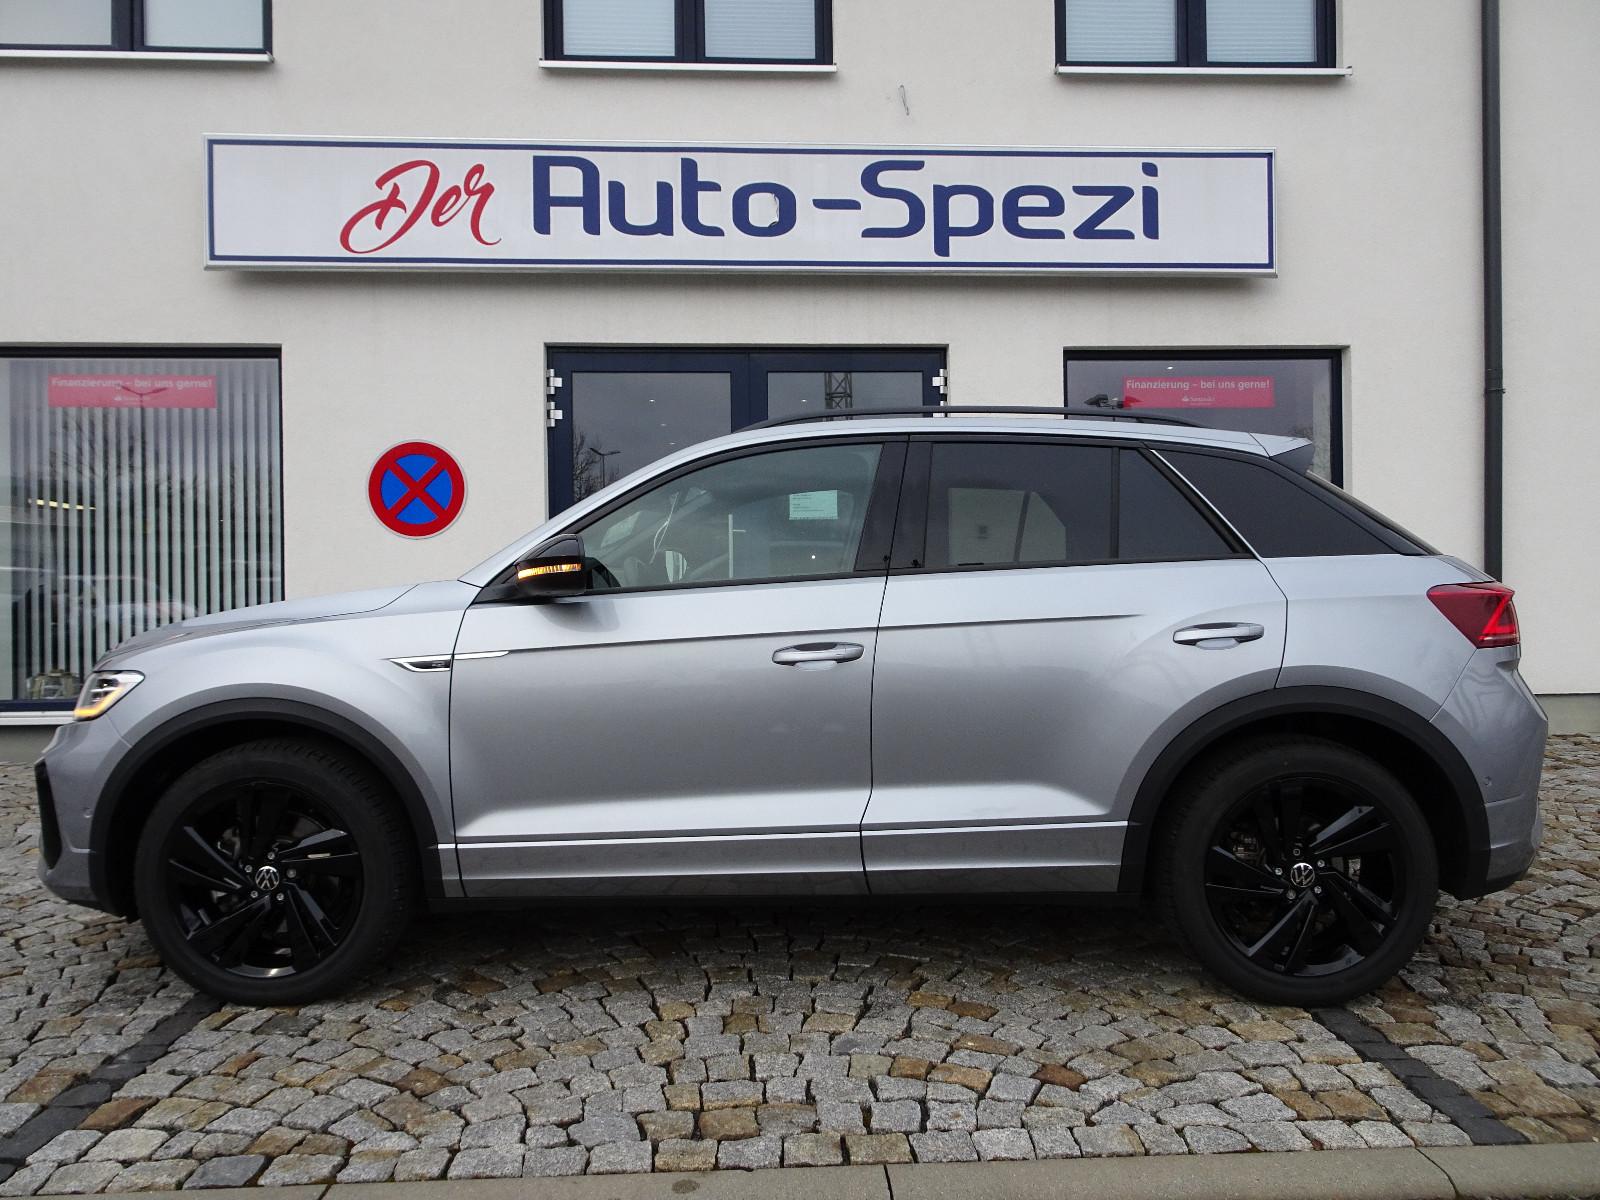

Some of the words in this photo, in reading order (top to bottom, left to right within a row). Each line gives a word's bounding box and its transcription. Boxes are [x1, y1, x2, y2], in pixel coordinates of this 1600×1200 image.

[340, 159, 502, 254] Der
[533, 156, 1159, 258] Auto-Spezi
[51, 377, 122, 391] Finanzierung
[133, 378, 152, 388] bei
[154, 380, 174, 388] uns
[175, 379, 213, 391] gerne!
[1126, 379, 1190, 391] Finanzierung
[1200, 379, 1216, 389] bei
[1218, 381, 1235, 389] uns
[1238, 379, 1270, 391] gerne!
